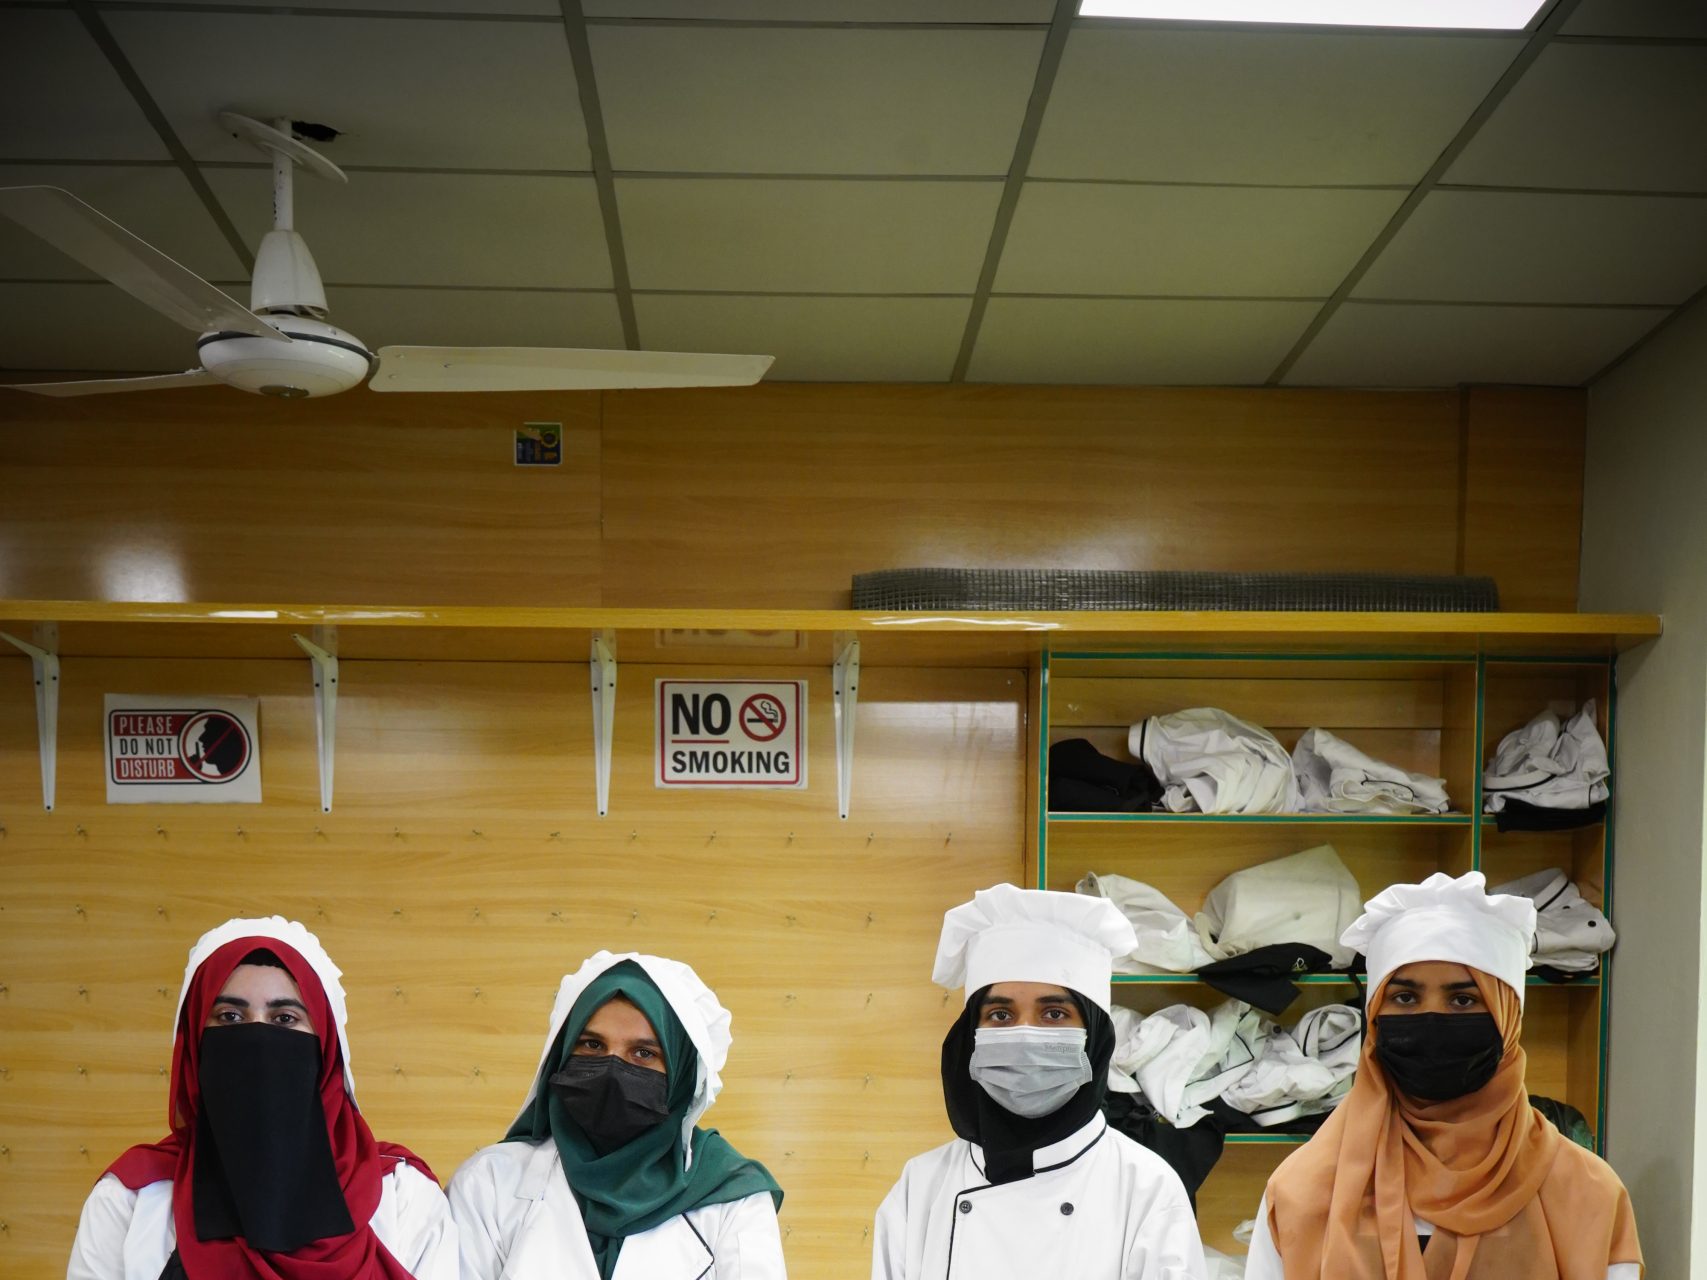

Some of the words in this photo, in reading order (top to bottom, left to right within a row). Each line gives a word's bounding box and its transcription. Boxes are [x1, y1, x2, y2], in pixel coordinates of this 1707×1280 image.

[672, 693, 731, 736] NO
[119, 716, 173, 735] PLEASE
[119, 738, 139, 756] DO
[145, 738, 174, 756] NOT
[120, 760, 176, 778] DISTURB
[671, 750, 790, 774] SMOKING
